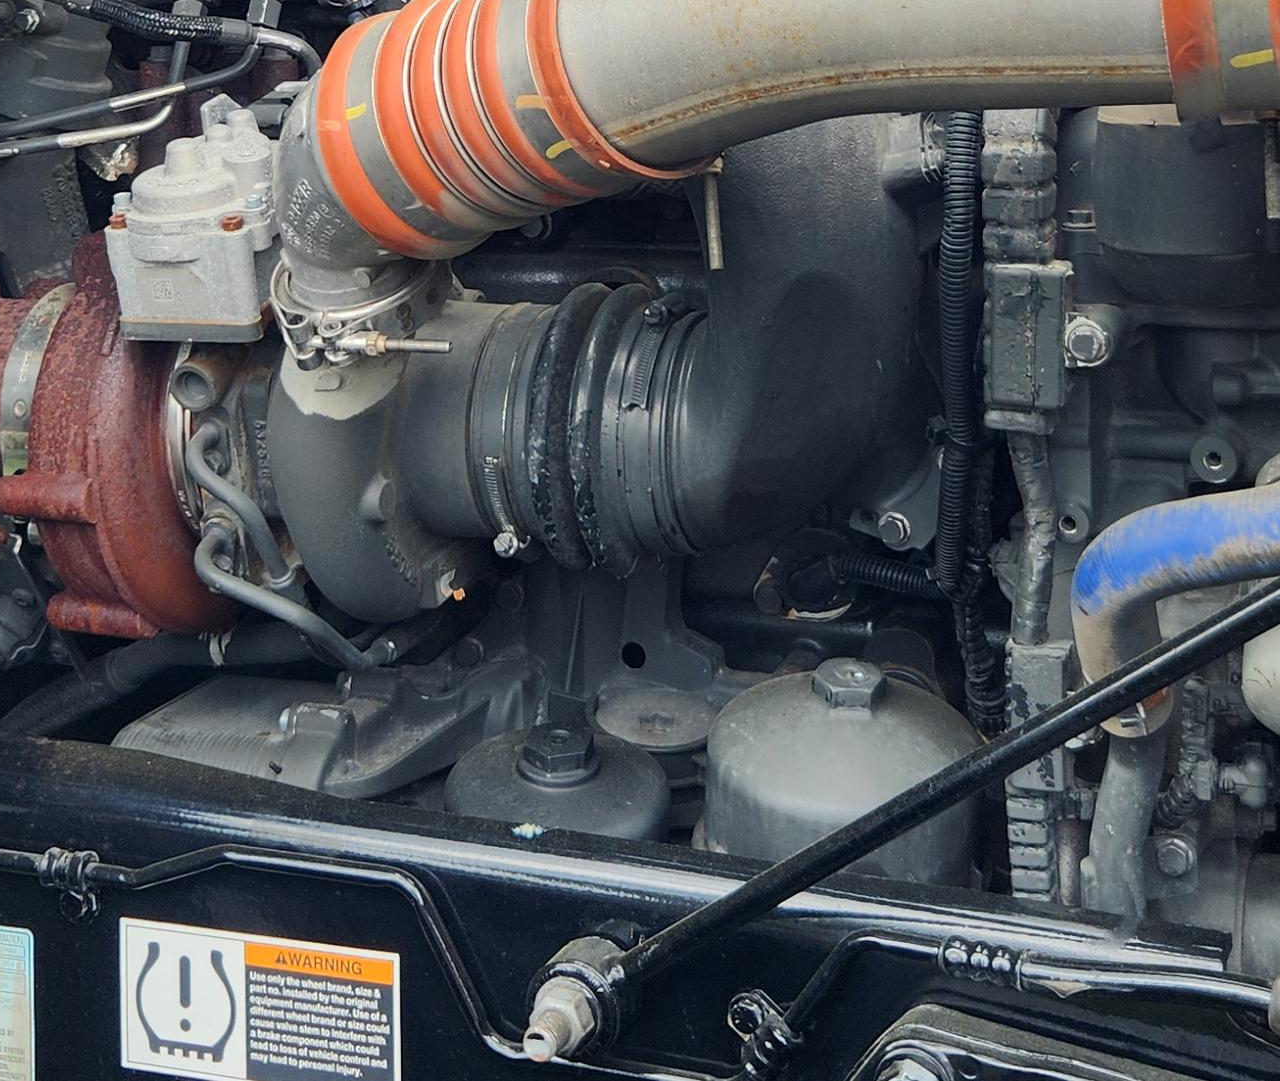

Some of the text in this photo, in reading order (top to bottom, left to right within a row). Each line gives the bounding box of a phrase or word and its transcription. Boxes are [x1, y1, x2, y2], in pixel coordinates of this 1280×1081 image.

[288, 951, 363, 976] WARNING
[249, 970, 381, 999] Use only the wheel brand, size &
[249, 983, 378, 1009] part no. installed by the original
[249, 995, 388, 1023] equipment manufacturer. Use of a
[249, 1005, 391, 1035] different wheel brand or size could
[250, 1017, 387, 1046] cause valve stem to interfere with
[250, 1029, 380, 1056] a brake component which could
[250, 1039, 388, 1069] lead to loss of vehicle control and
[250, 1052, 363, 1078] may lead to personal injury.
